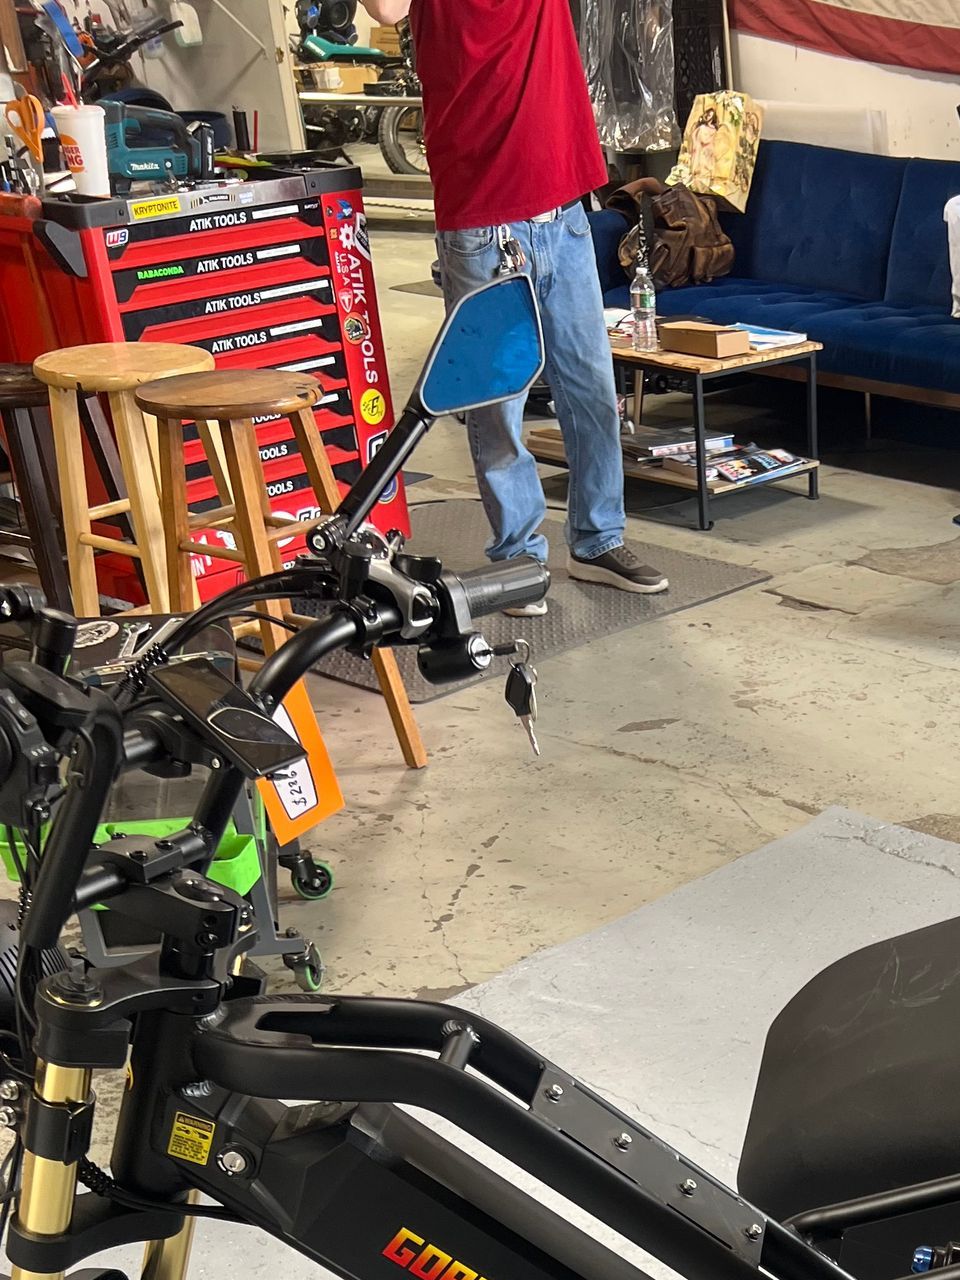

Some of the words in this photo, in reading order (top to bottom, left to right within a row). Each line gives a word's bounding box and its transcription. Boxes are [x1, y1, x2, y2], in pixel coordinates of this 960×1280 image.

[133, 200, 179, 216] KRYPTONITE
[189, 218, 213, 232] ATIK
[214, 211, 247, 229] TOOLS
[137, 265, 185, 280] RABACONDA
[196, 258, 220, 274] ATIK
[220, 252, 254, 269] TOOLS
[347, 253, 367, 305] ATIK
[204, 298, 228, 314] ATIK
[228, 292, 261, 310] TOOLS
[211, 338, 235, 354] ATIK
[234, 331, 267, 349] TOOLS
[258, 444, 288, 461] TOOLS
